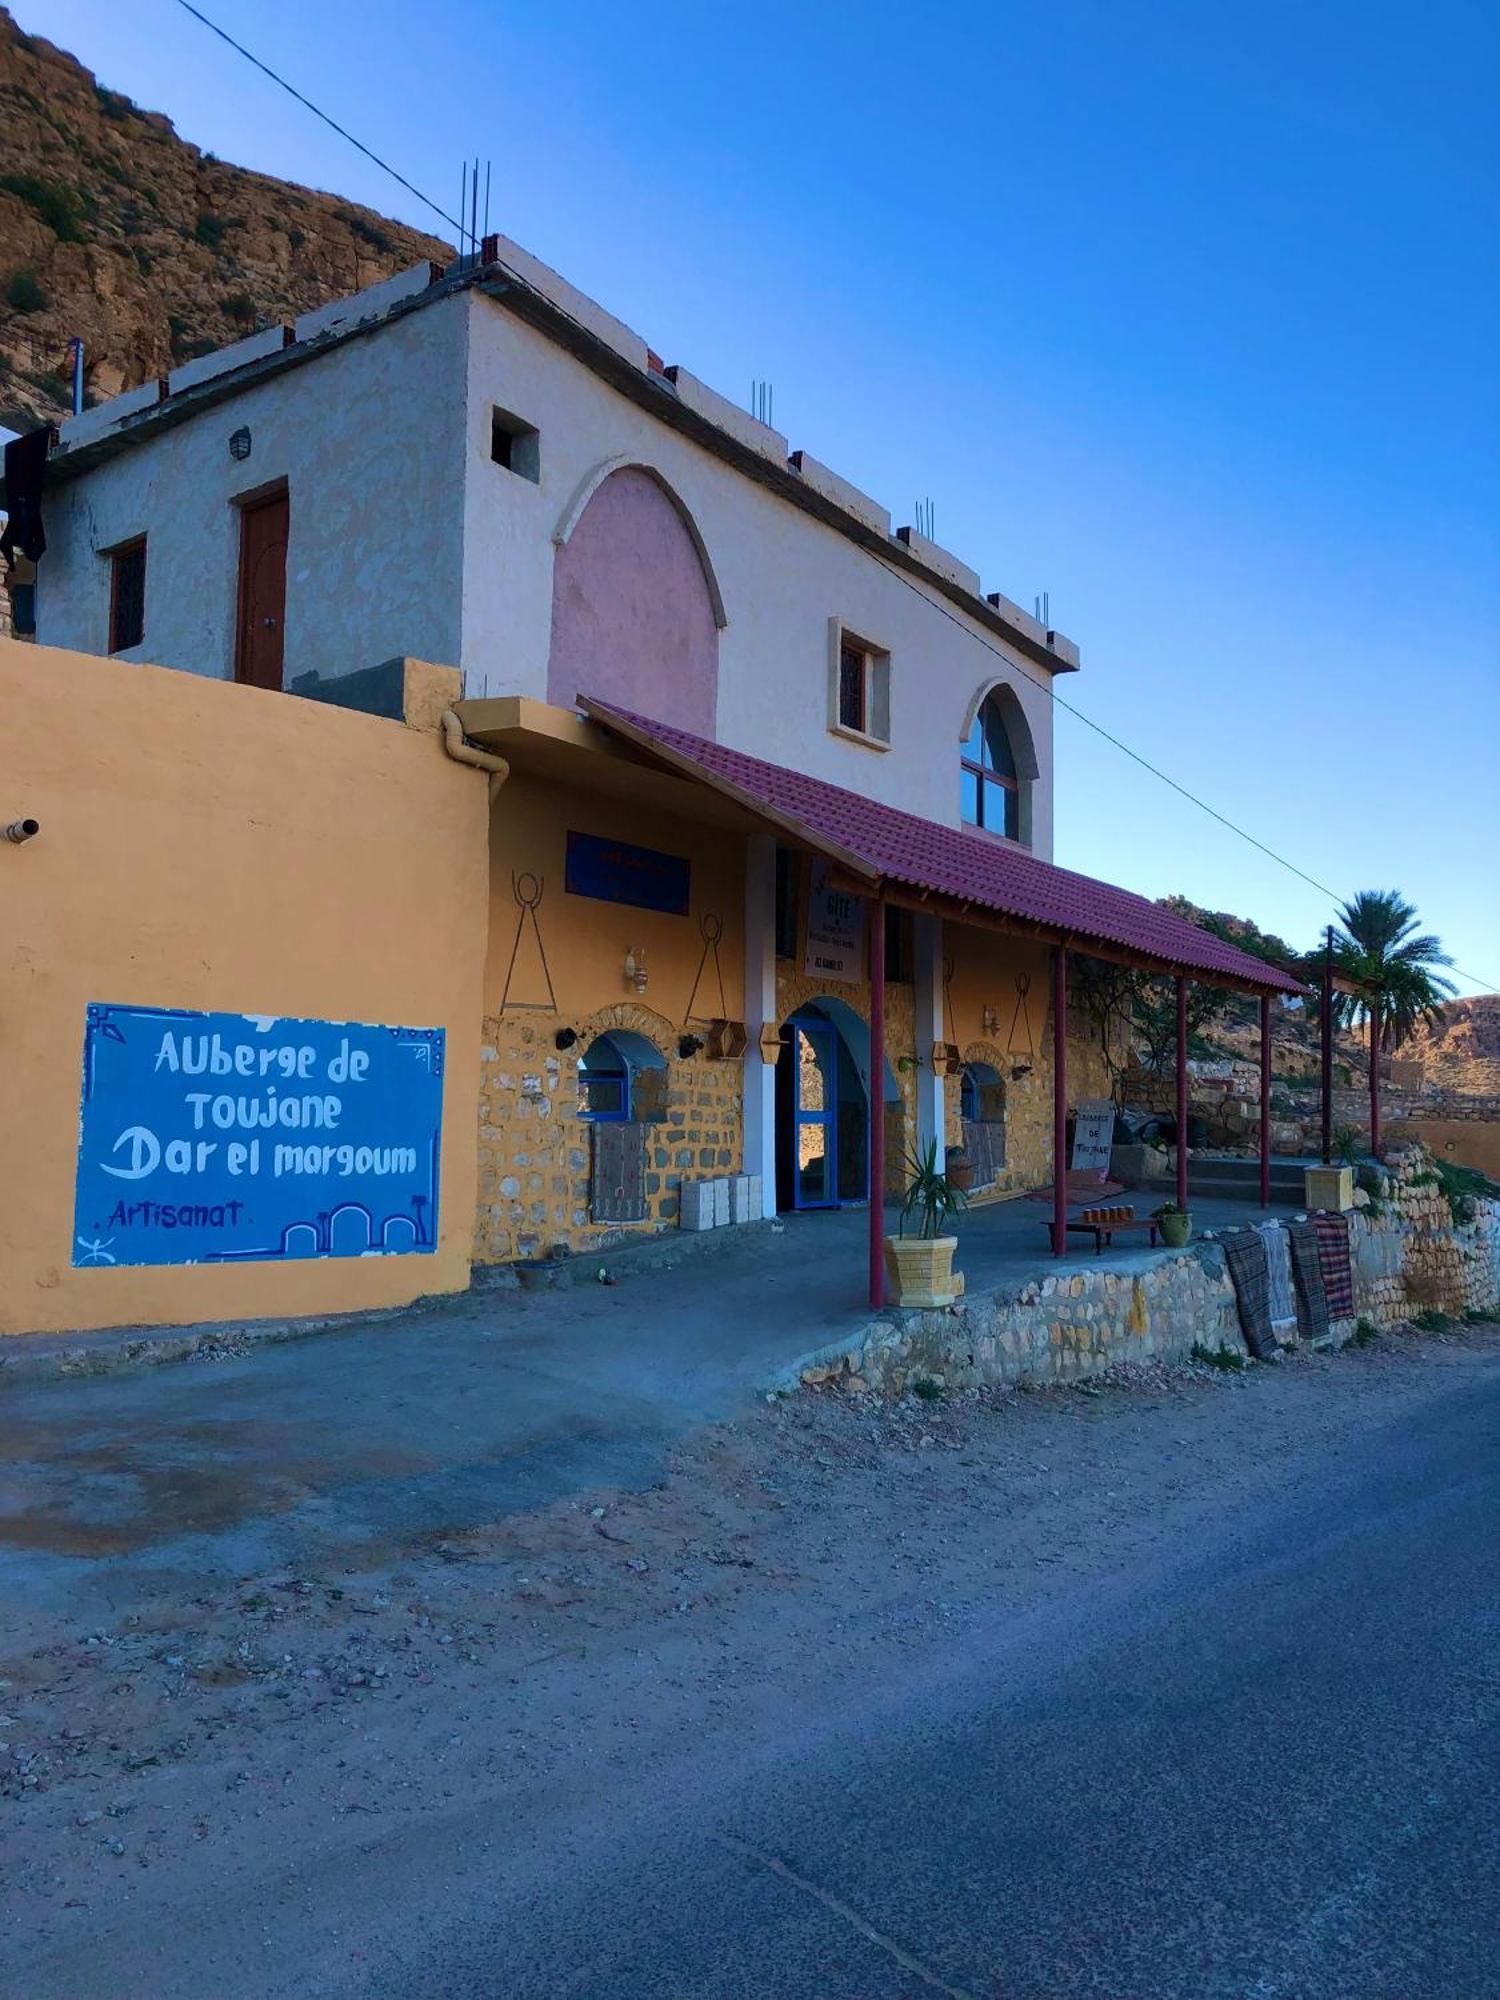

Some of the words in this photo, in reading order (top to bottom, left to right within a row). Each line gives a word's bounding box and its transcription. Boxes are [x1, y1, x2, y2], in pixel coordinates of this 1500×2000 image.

[327, 1038, 371, 1083] de
[100, 1126, 218, 1180] Dar
[227, 1139, 260, 1176] el
[274, 1143, 417, 1178] margoum
